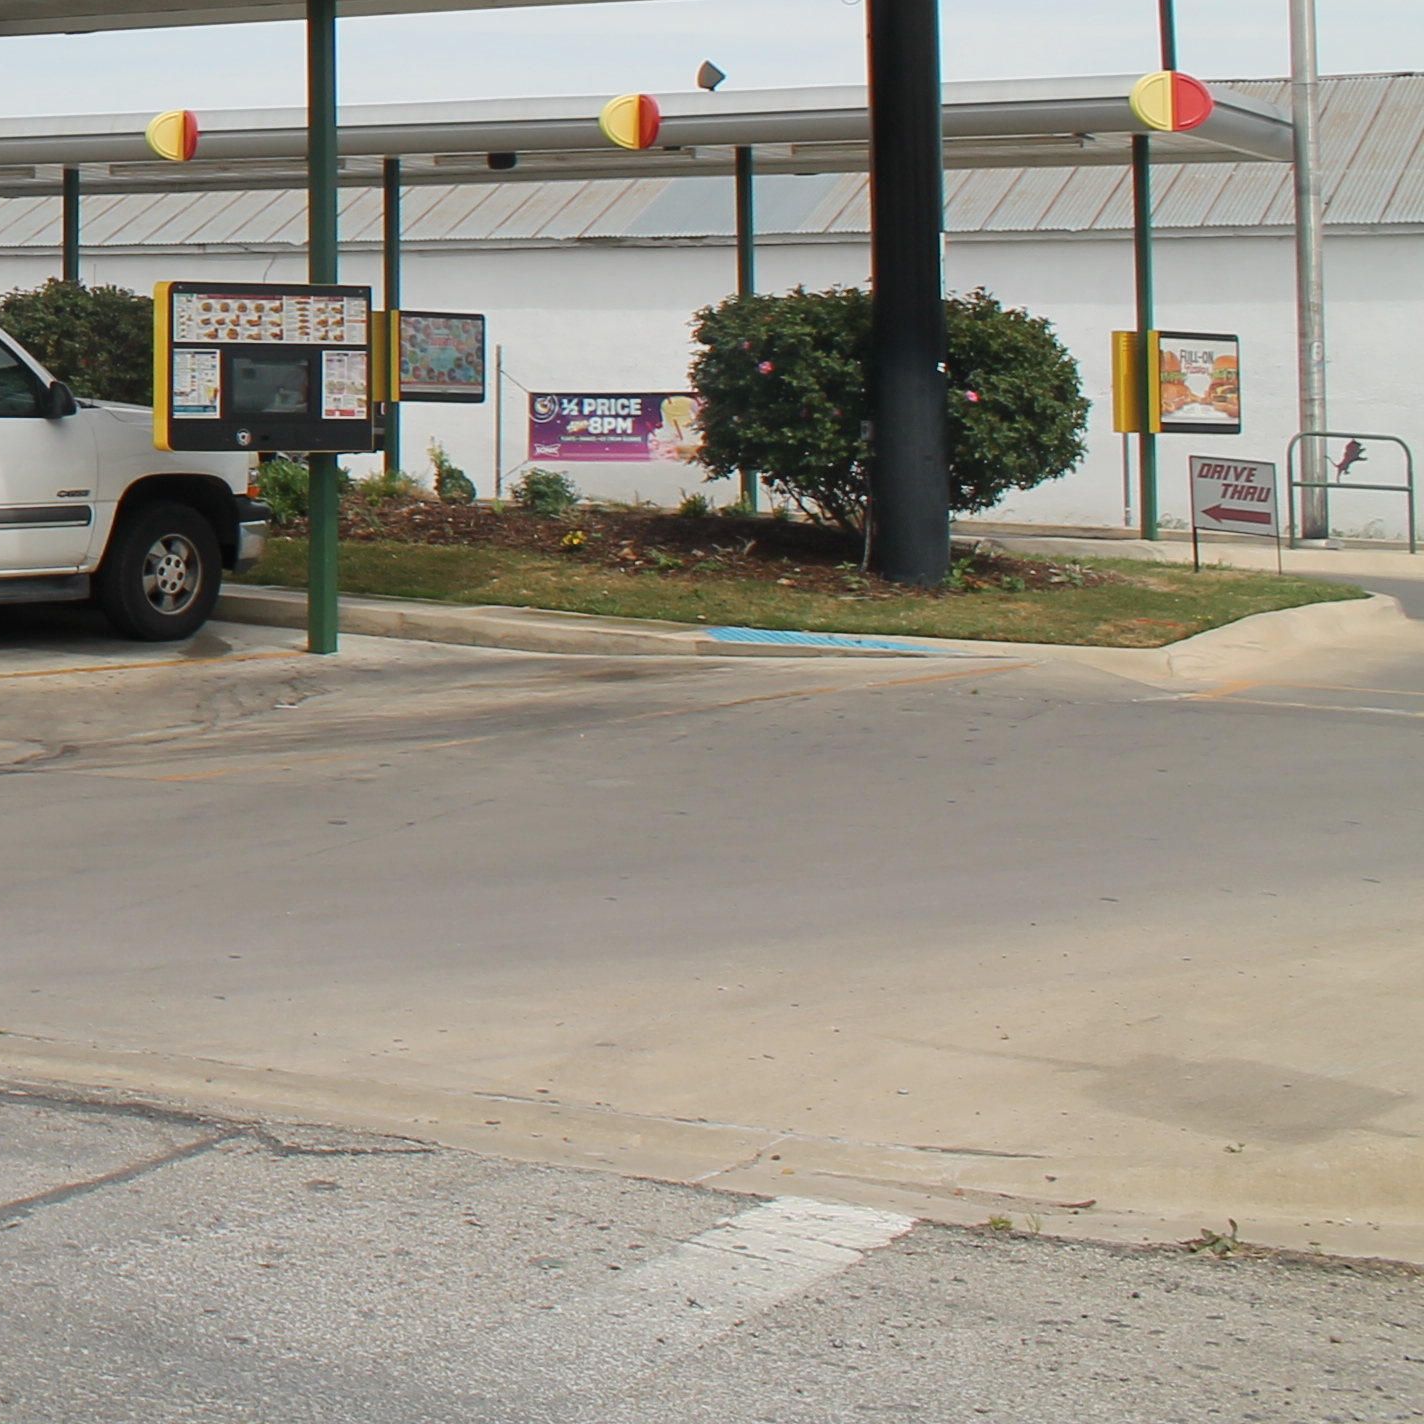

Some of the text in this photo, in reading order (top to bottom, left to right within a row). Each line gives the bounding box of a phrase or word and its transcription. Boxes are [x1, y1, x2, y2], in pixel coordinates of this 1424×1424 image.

[1179, 349, 1214, 364] FULL-ON
[582, 398, 642, 416] PRICE
[588, 417, 633, 434] 8PM
[1197, 462, 1258, 483] DRIVE
[1220, 482, 1272, 503] THRU
